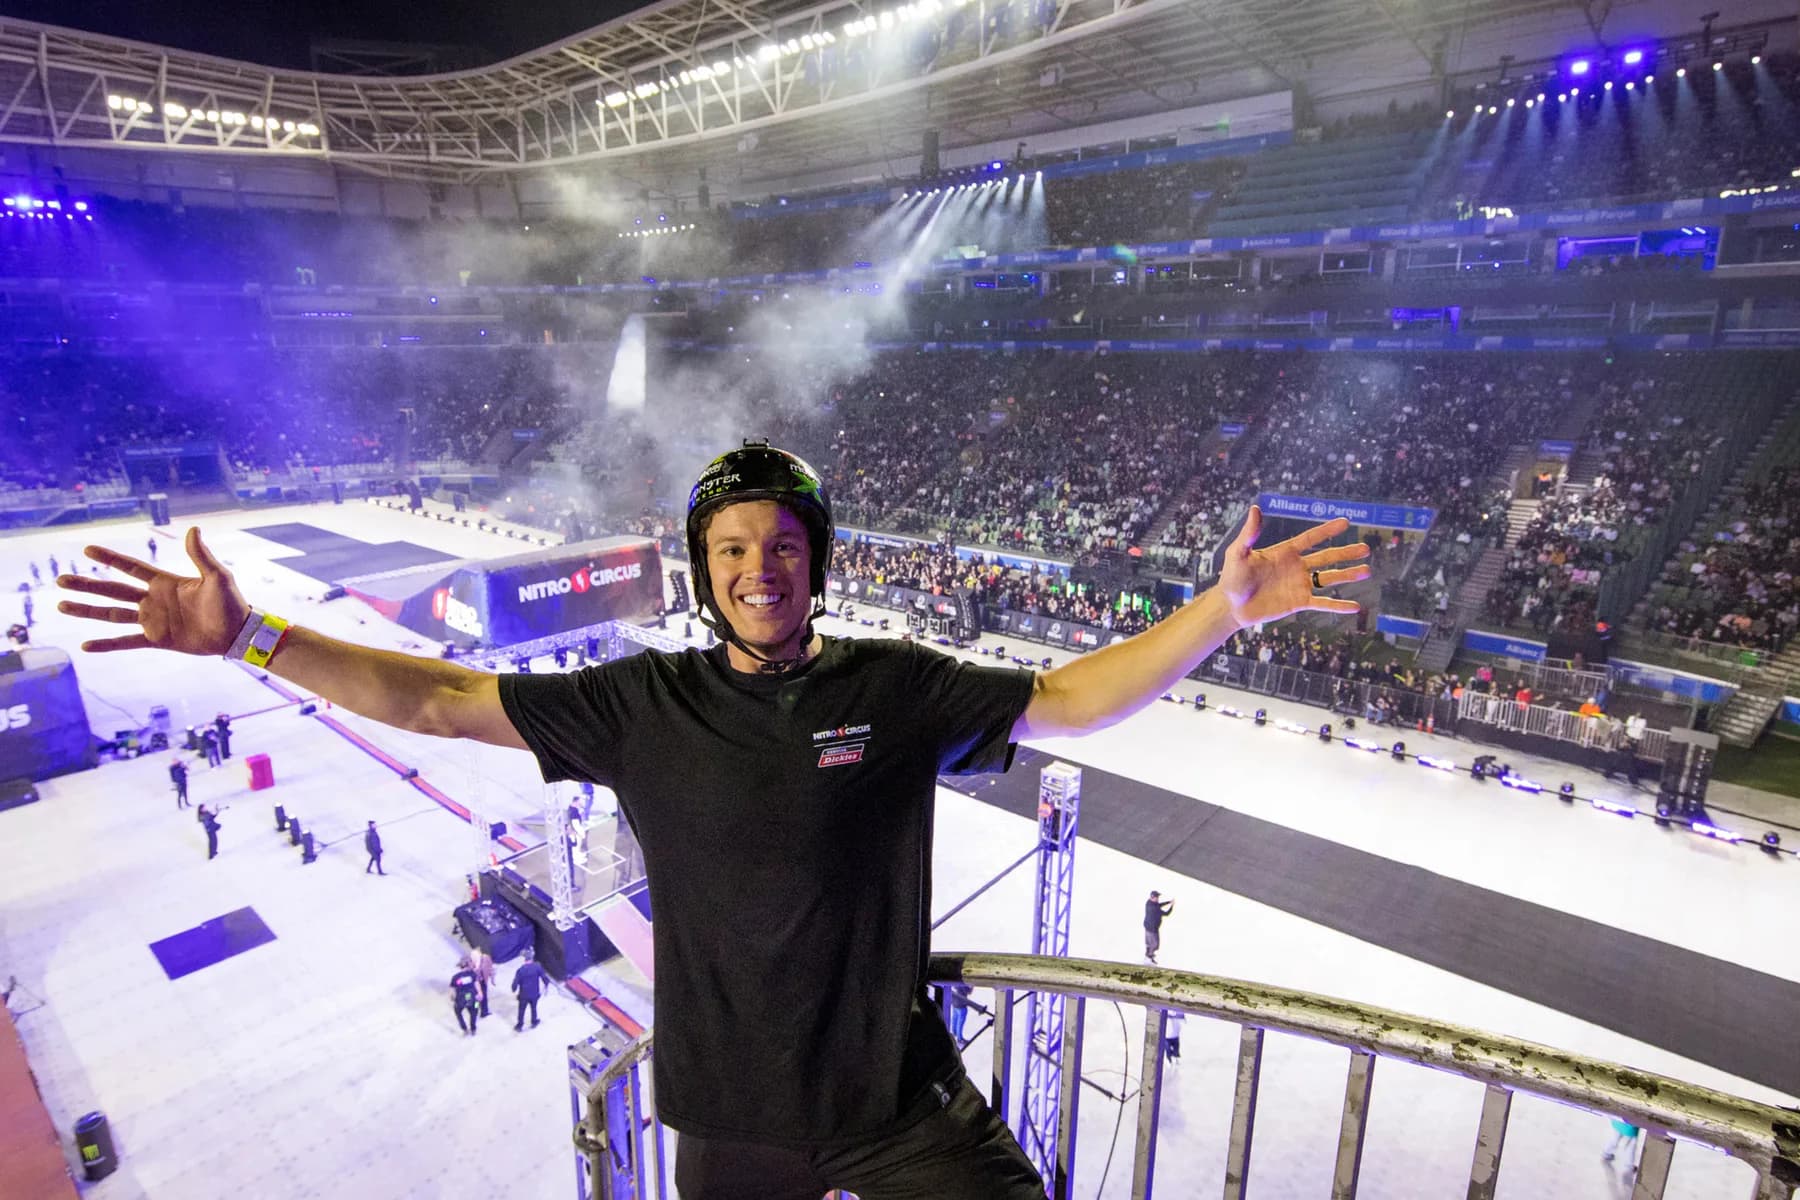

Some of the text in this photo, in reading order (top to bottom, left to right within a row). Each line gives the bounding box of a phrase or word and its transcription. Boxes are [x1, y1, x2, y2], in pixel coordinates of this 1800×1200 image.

[1268, 498, 1309, 513] Allianz
[1328, 504, 1368, 519] Parque
[518, 563, 642, 603] NITRO CIRCUS
[813, 724, 871, 740] NITRO CIRCUS
[824, 754, 858, 763] Dickies
